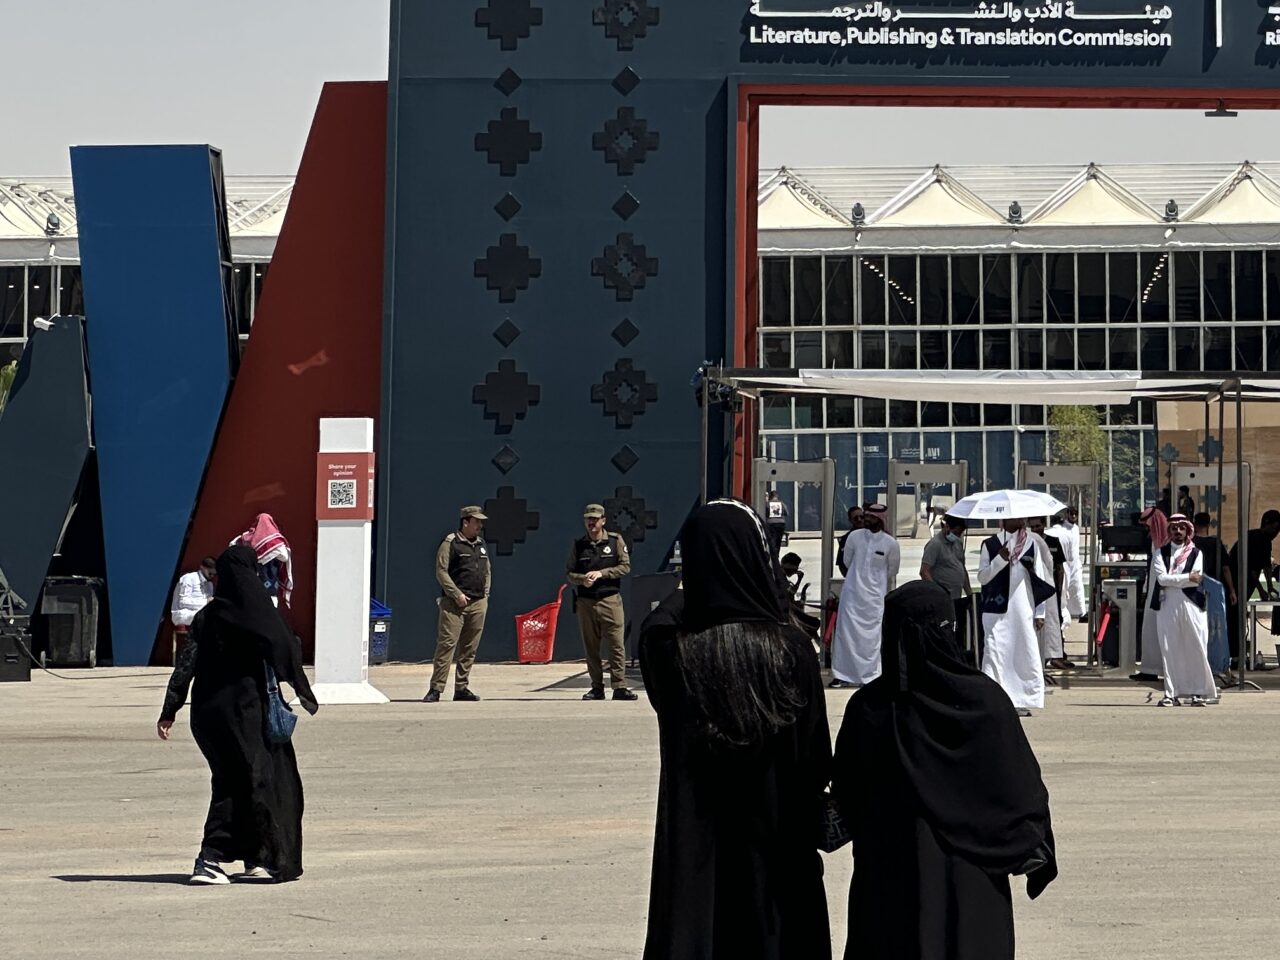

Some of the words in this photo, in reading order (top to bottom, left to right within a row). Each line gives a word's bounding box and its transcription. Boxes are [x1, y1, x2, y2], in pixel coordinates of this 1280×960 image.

[892, 1, 1021, 22] والنشر
[1024, 0, 1063, 23] الأدب
[1065, 0, 1172, 24] هيئة
[750, 25, 847, 47] Literature,
[848, 26, 938, 49] Publishing
[940, 27, 954, 45] &
[956, 27, 1056, 46] Translation
[1058, 28, 1172, 46] Commission
